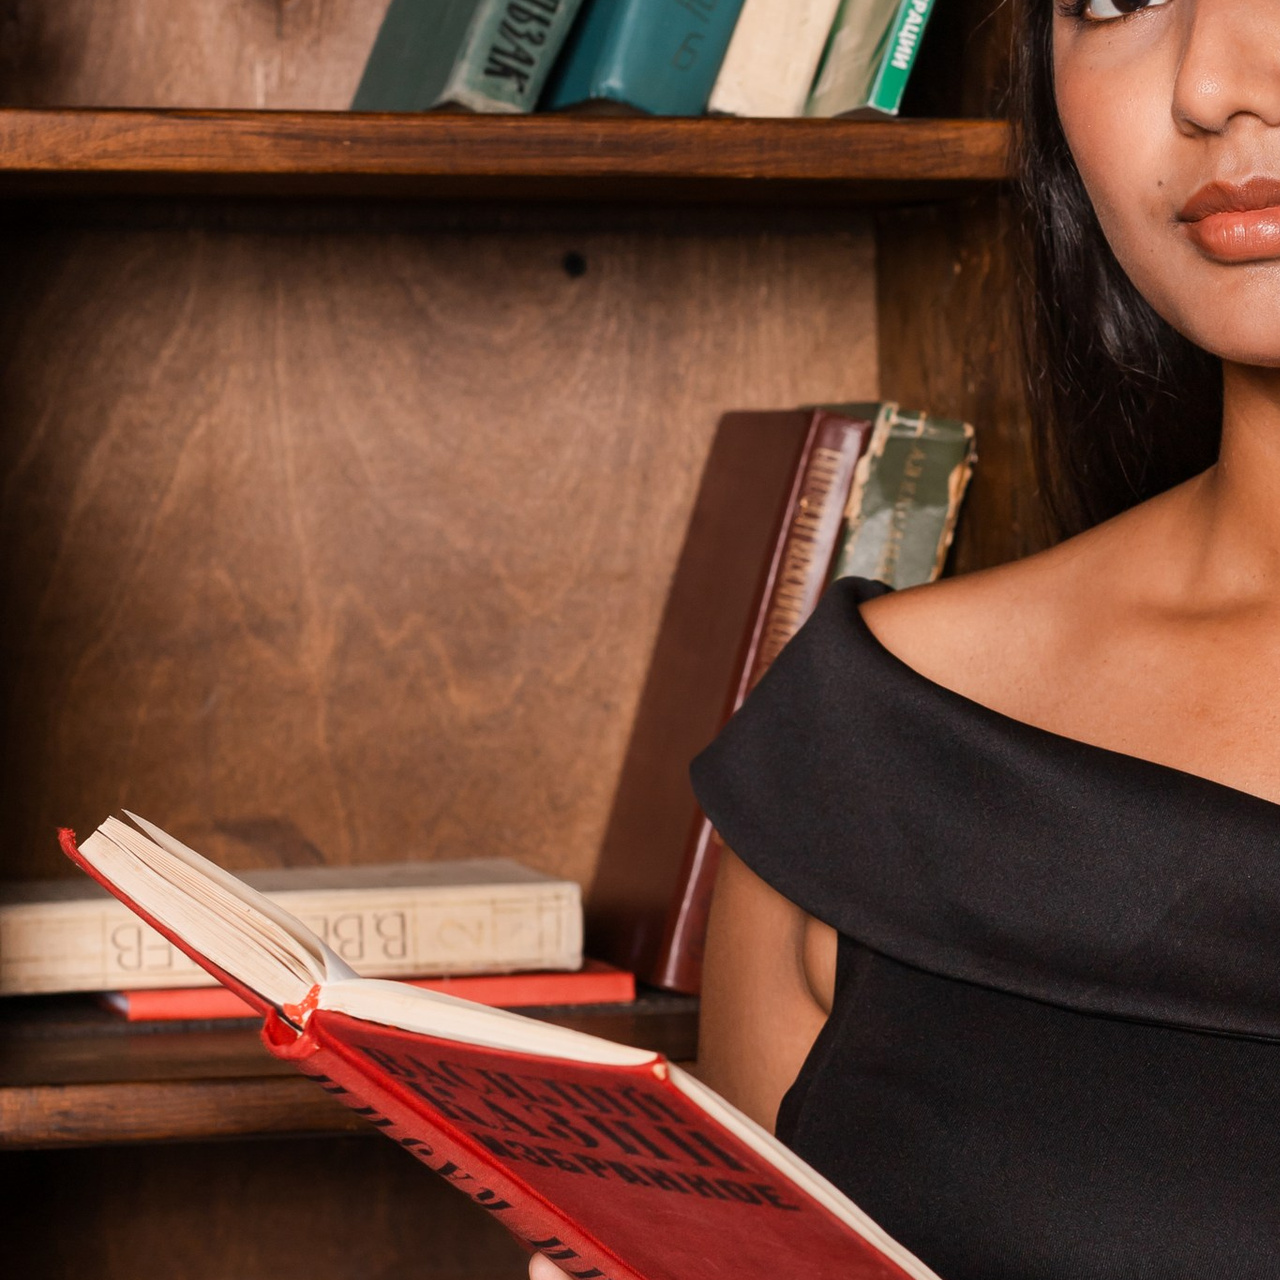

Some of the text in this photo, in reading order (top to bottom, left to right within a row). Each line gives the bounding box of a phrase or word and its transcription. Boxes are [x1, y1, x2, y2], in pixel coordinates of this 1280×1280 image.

[355, 1045, 685, 1122] ВАСИЛИЙ
[405, 1082, 748, 1172] КАЗИН
[468, 1133, 800, 1211] ИЗБРАННОЕ
